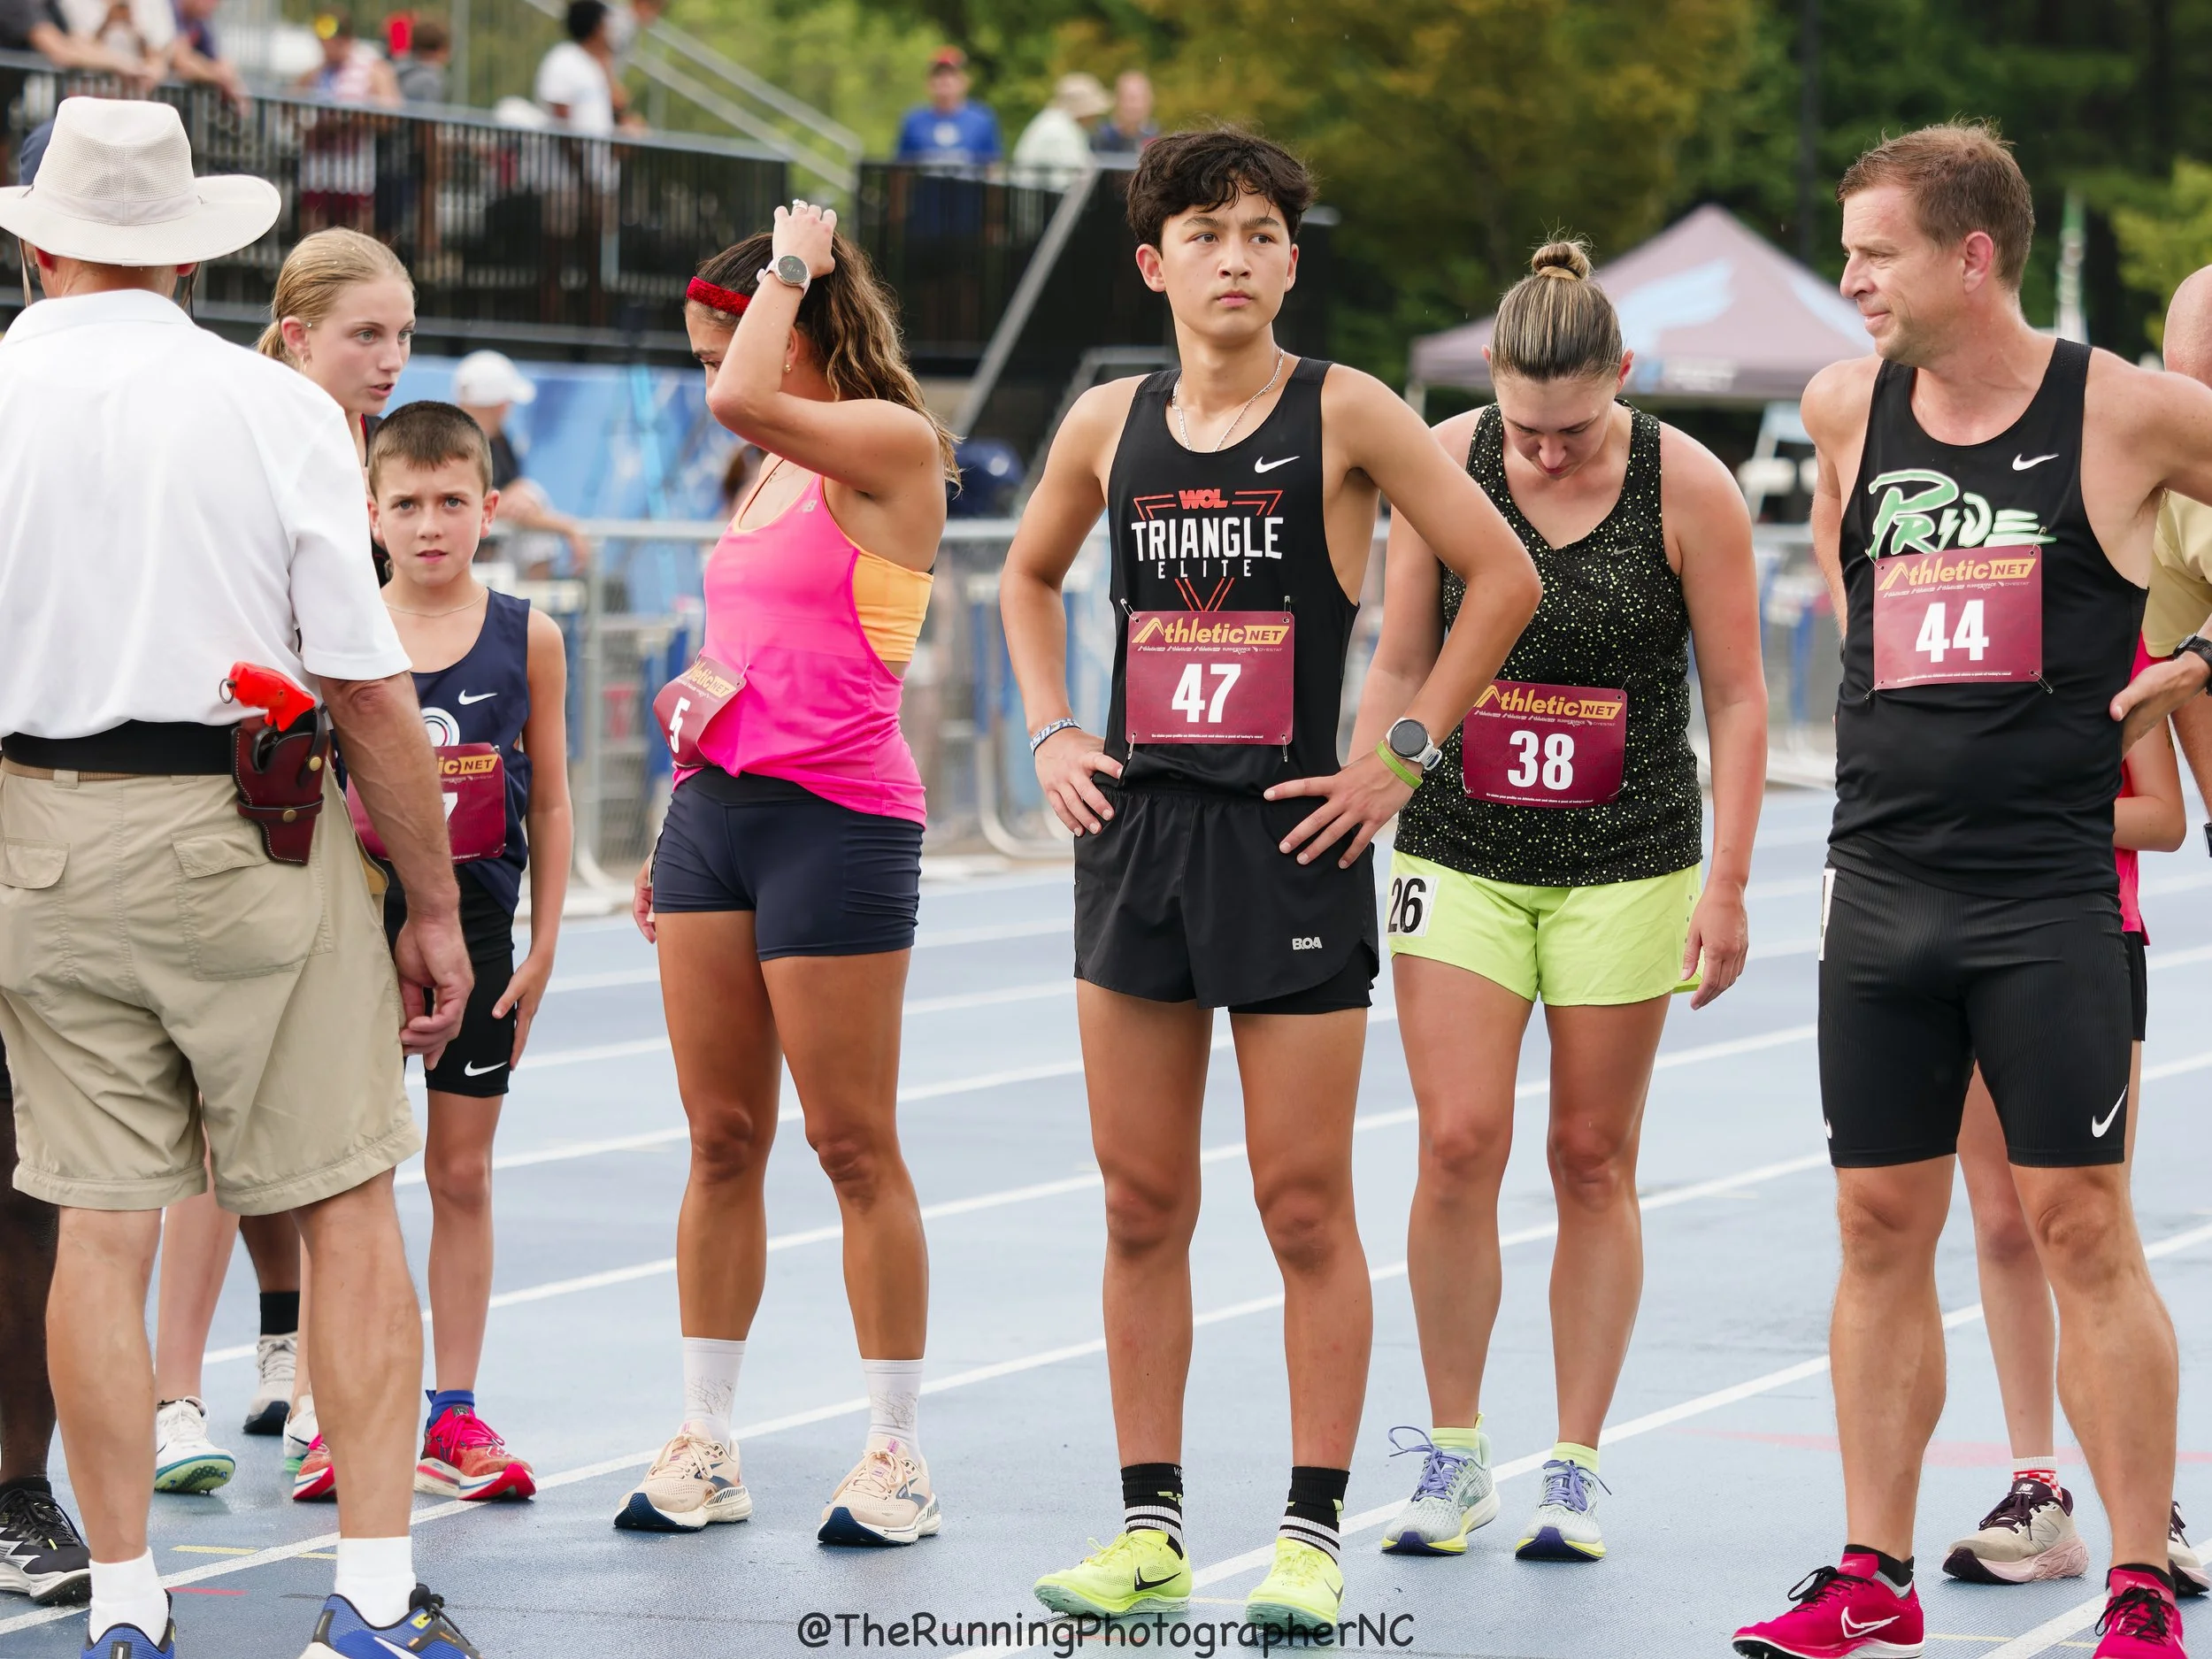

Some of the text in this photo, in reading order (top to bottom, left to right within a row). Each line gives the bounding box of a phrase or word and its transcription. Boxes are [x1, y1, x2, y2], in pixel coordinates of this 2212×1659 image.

[1178, 488, 1229, 510] WOL
[1868, 468, 2057, 559] PRIDE
[1131, 517, 1284, 562] TRIANGLE
[1157, 559, 1251, 580] ELITE
[1915, 599, 1990, 663] 44
[1171, 663, 1241, 724] 47
[669, 696, 690, 754] 5
[1508, 730, 1575, 790] 38
[1387, 877, 1426, 933] 26
